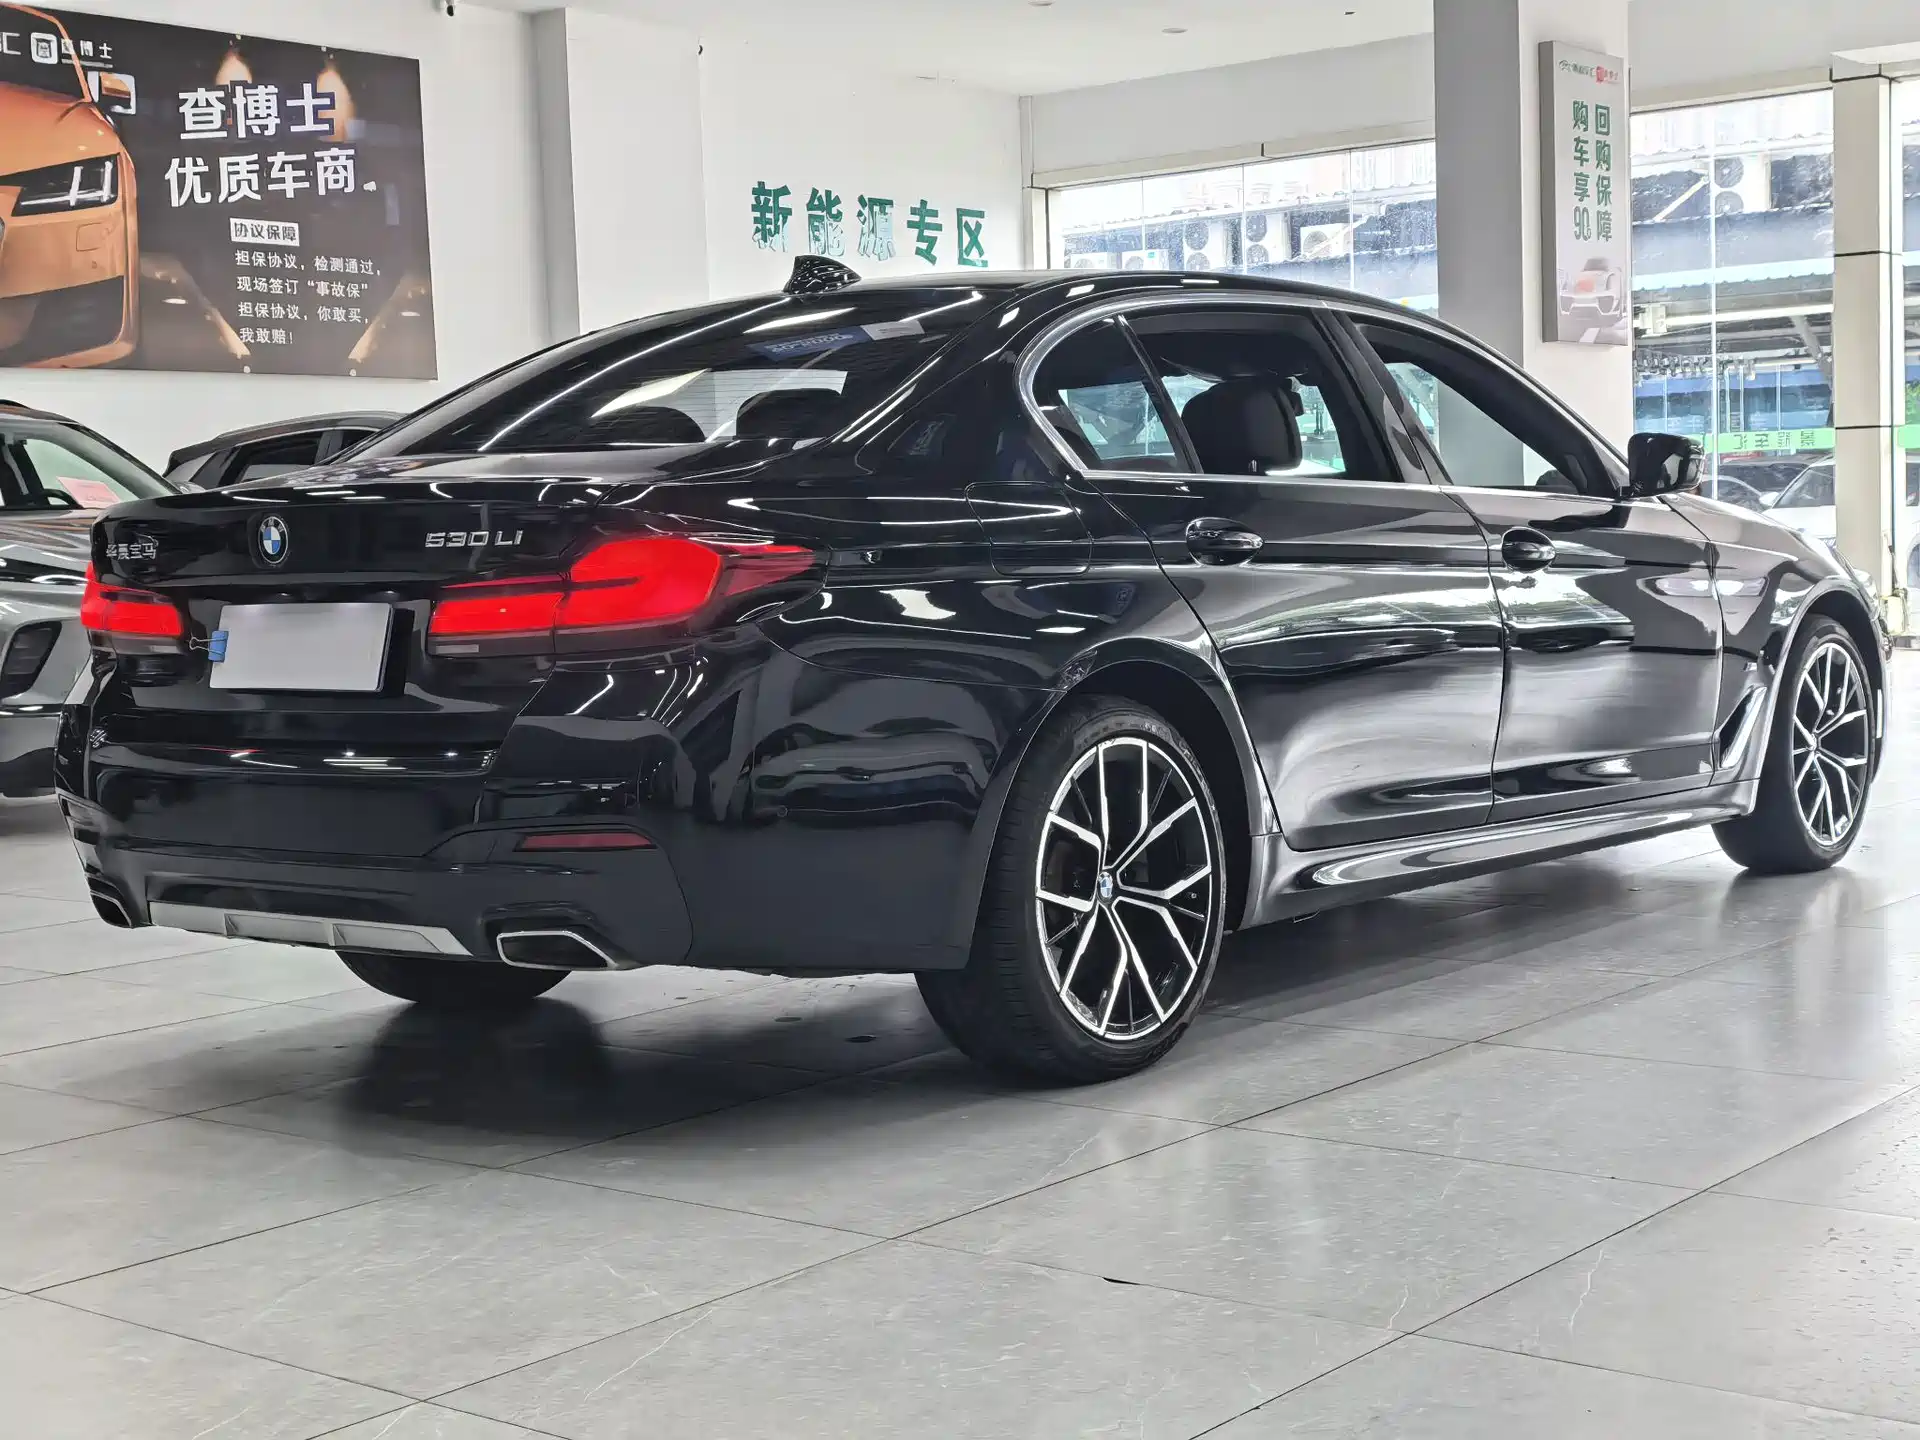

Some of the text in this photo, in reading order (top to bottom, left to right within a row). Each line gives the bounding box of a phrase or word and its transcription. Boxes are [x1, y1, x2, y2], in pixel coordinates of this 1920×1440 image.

[178, 83, 331, 140] 查博士
[1595, 103, 1612, 242] 回购保障
[234, 222, 297, 242] 协议保障
[751, 181, 989, 268] 新能源专区
[105, 543, 157, 561] 华晨宝马
[425, 531, 489, 548] 530
